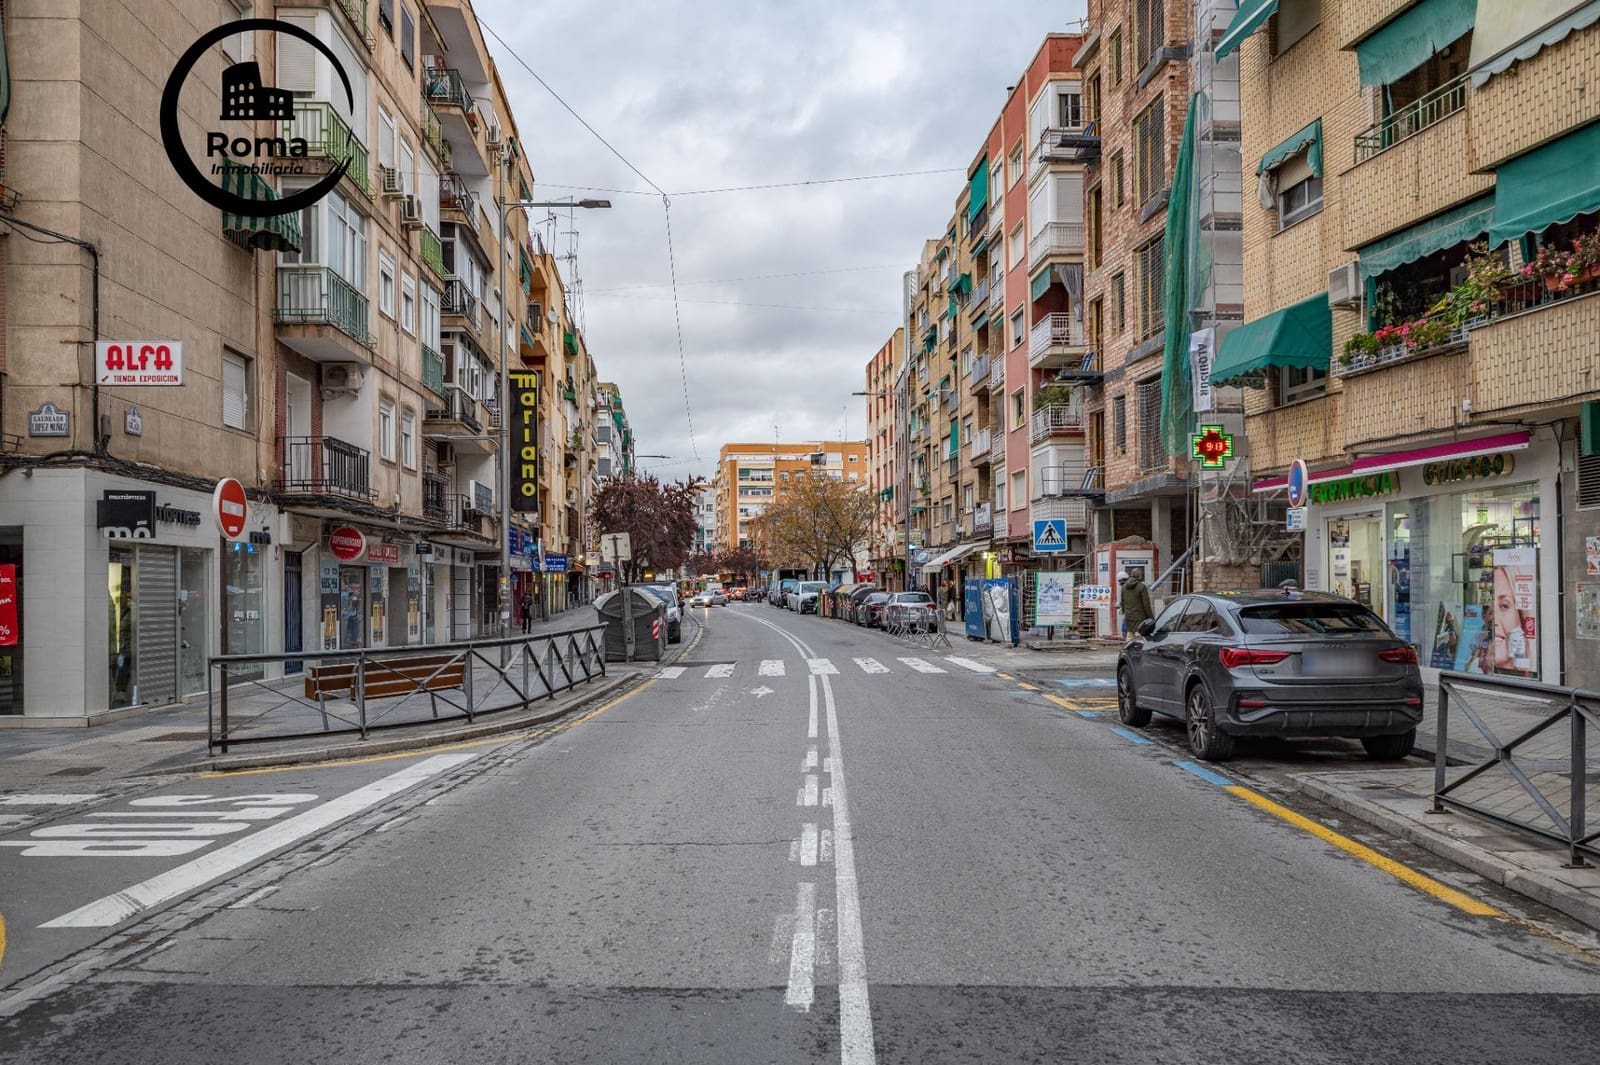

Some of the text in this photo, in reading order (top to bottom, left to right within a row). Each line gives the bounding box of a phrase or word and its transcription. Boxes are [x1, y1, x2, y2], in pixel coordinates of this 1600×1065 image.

[105, 344, 174, 371] ALFA
[113, 375, 179, 383] TIENDA EXPOSICION
[509, 373, 537, 497] mariano
[1311, 471, 1397, 505] FARMACIA
